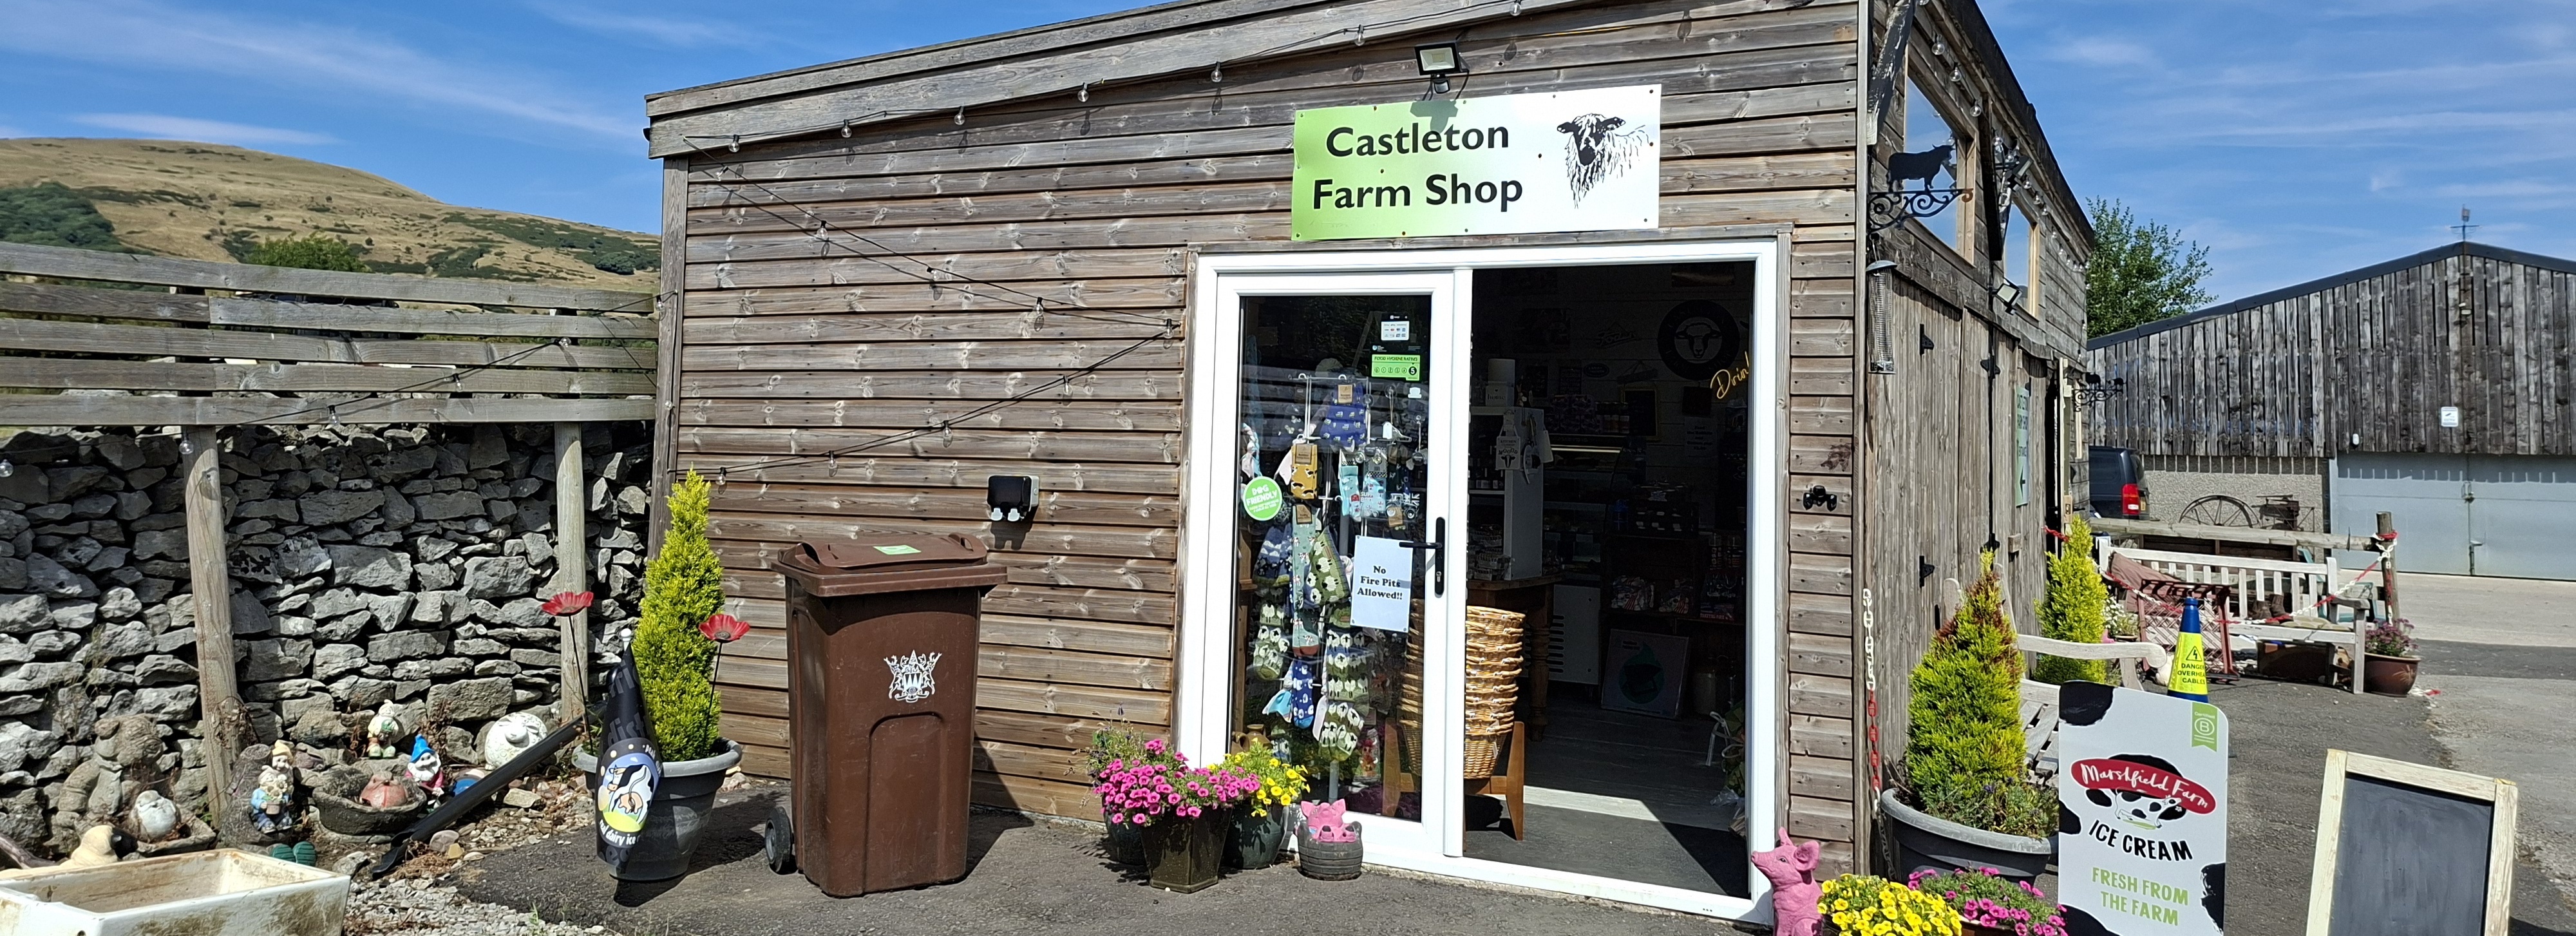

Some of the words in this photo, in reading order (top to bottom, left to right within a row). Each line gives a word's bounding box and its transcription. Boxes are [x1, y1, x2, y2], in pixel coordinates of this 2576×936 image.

[1325, 122, 1510, 158] Castleton
[1312, 178, 1412, 210] Farm
[1425, 173, 1524, 213] Shop
[1246, 489, 1278, 506] FRIENDLY
[1251, 484, 1269, 496] DOG
[1360, 576, 1379, 585] Fire
[1381, 578, 1401, 587] Pits
[1373, 566, 1387, 575] No
[1357, 587, 1403, 600] Allowed!!
[2200, 721, 2210, 732] B
[2079, 763, 2169, 789] Marshfield
[2172, 779, 2209, 808] Farm
[599, 819, 609, 836] real
[605, 829, 625, 846] dairy
[625, 834, 636, 845] ice
[2088, 819, 2120, 849] ICE
[2122, 833, 2193, 862] CREAM
[2091, 866, 2139, 893] FRESH
[2142, 879, 2190, 906] FROM
[2099, 890, 2128, 913] THE
[2131, 902, 2179, 926] FARM
